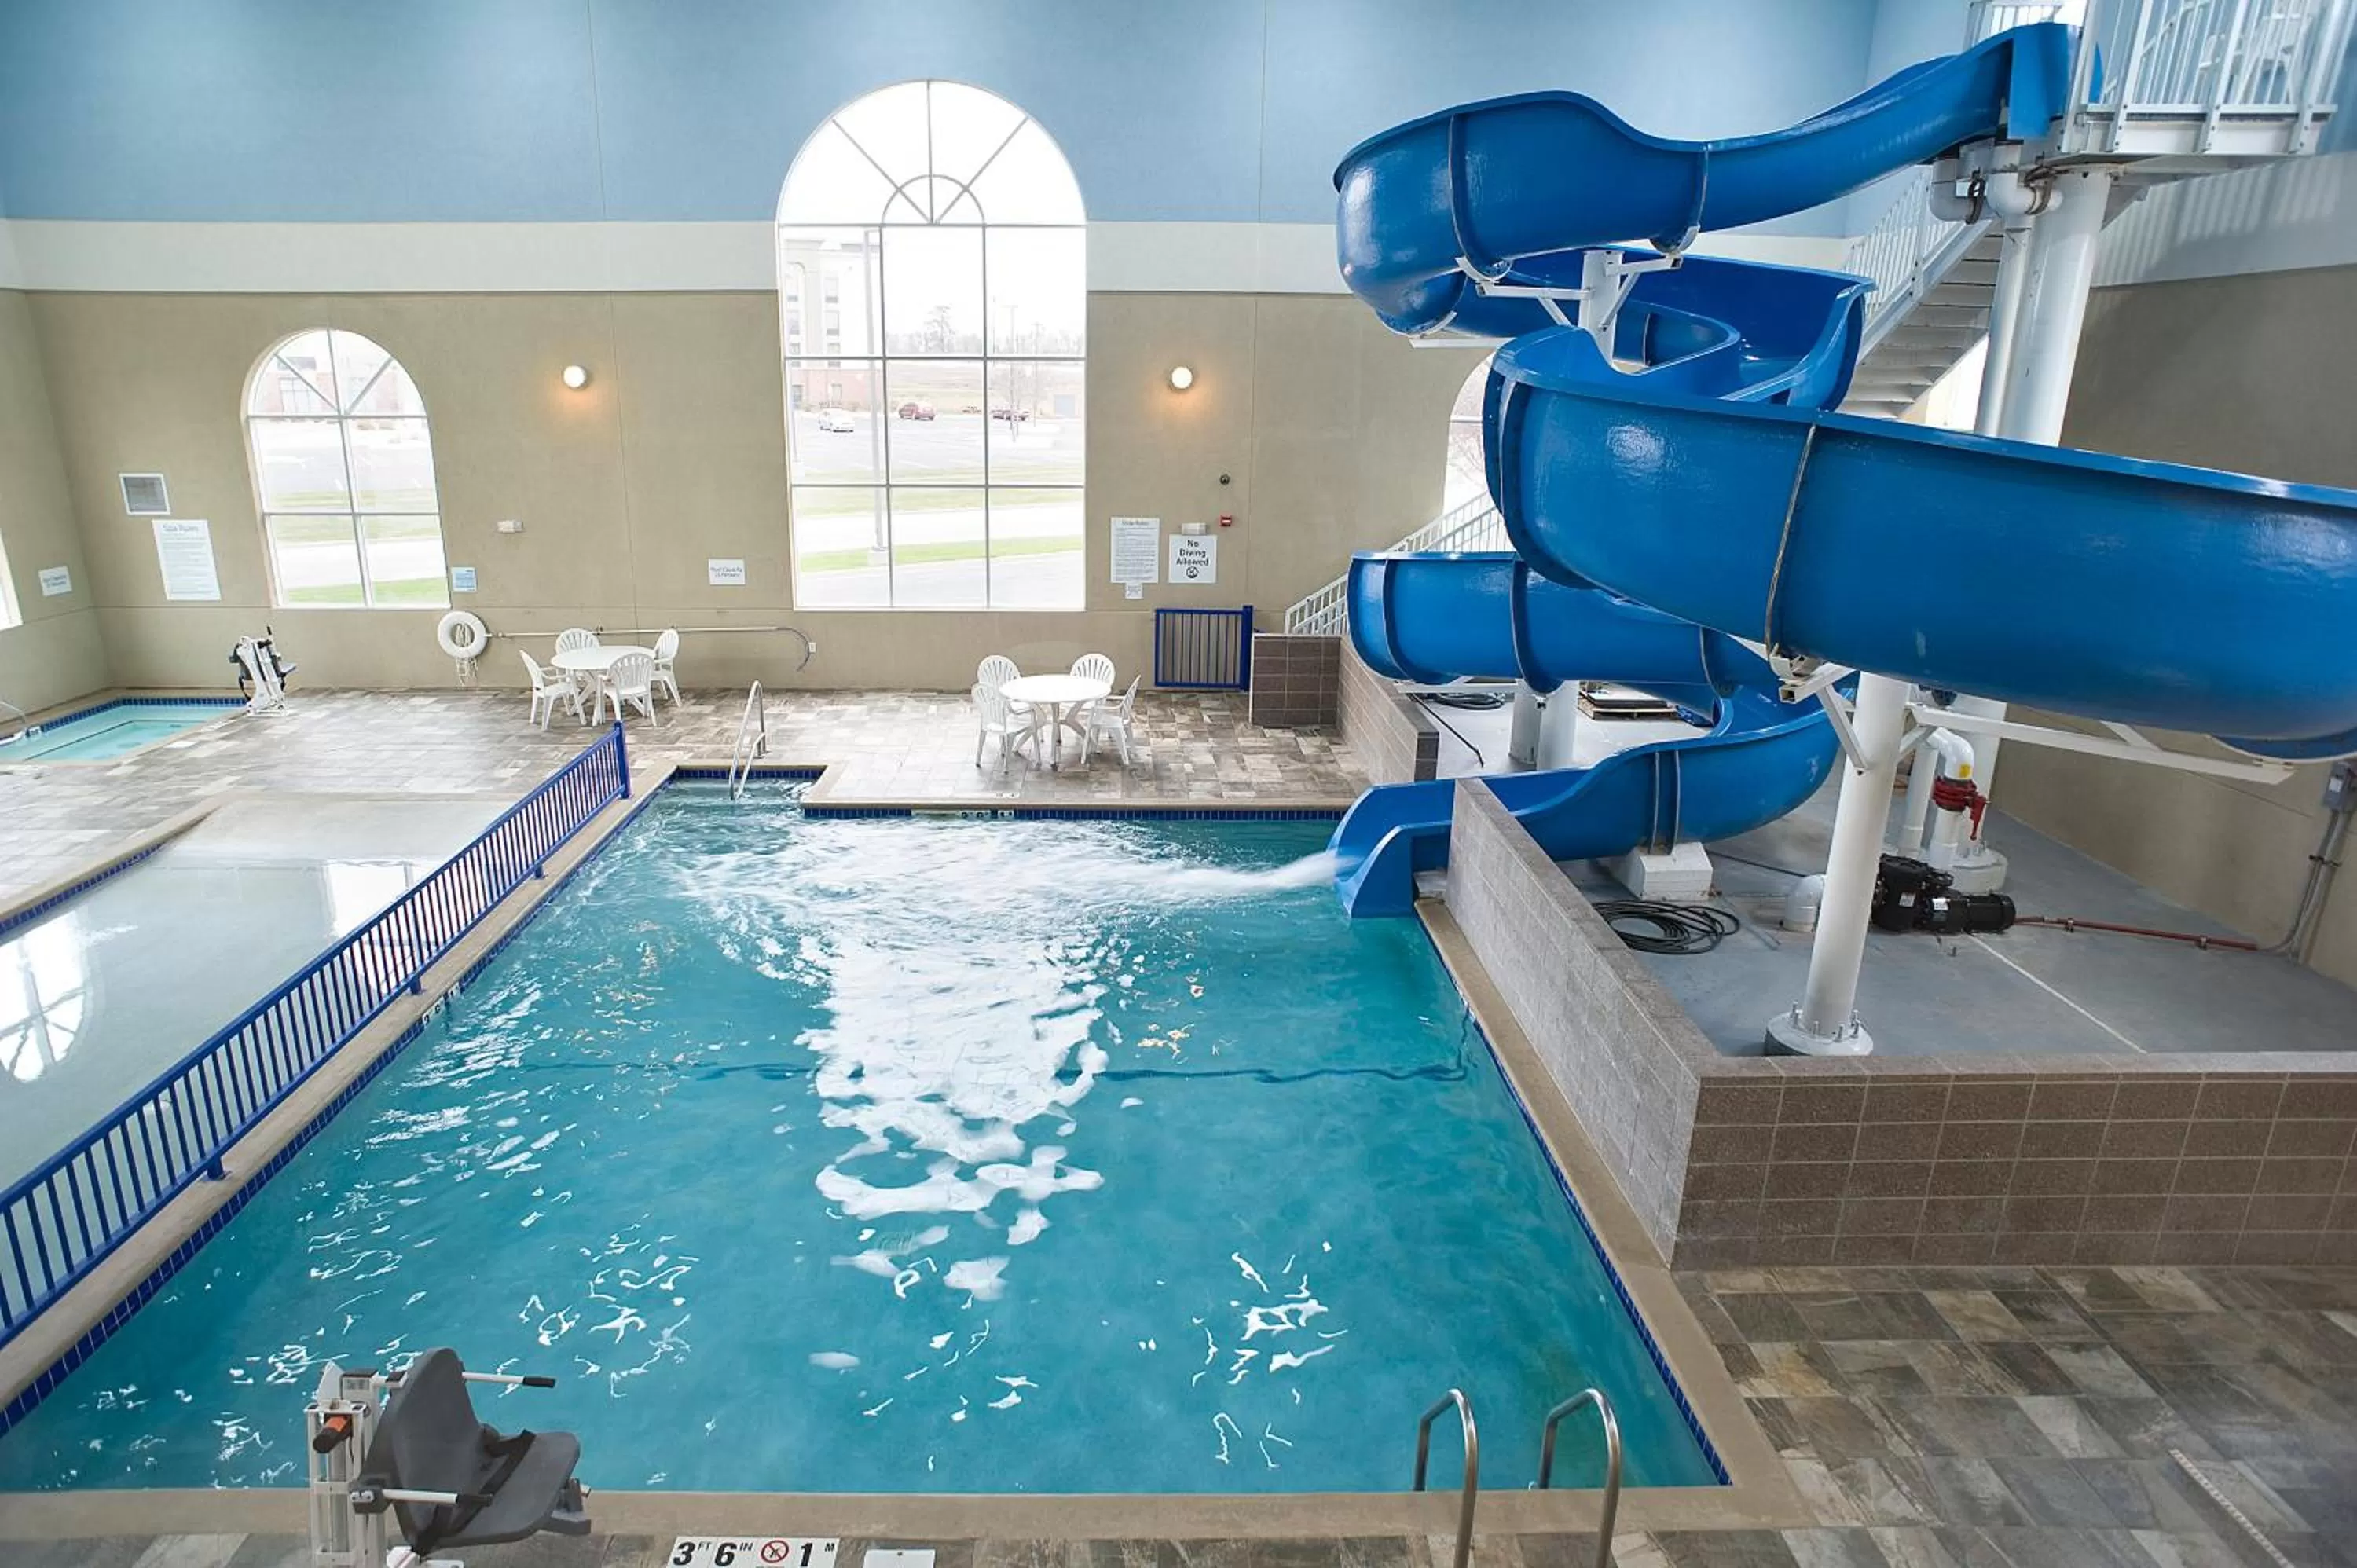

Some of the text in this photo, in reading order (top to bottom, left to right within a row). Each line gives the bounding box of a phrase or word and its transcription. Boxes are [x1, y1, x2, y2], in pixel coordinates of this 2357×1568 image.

[1179, 548, 1206, 559] Diving
[1176, 557, 1209, 566] Allowed
[673, 1541, 835, 1567] 3 FT 6 IN 1 M
